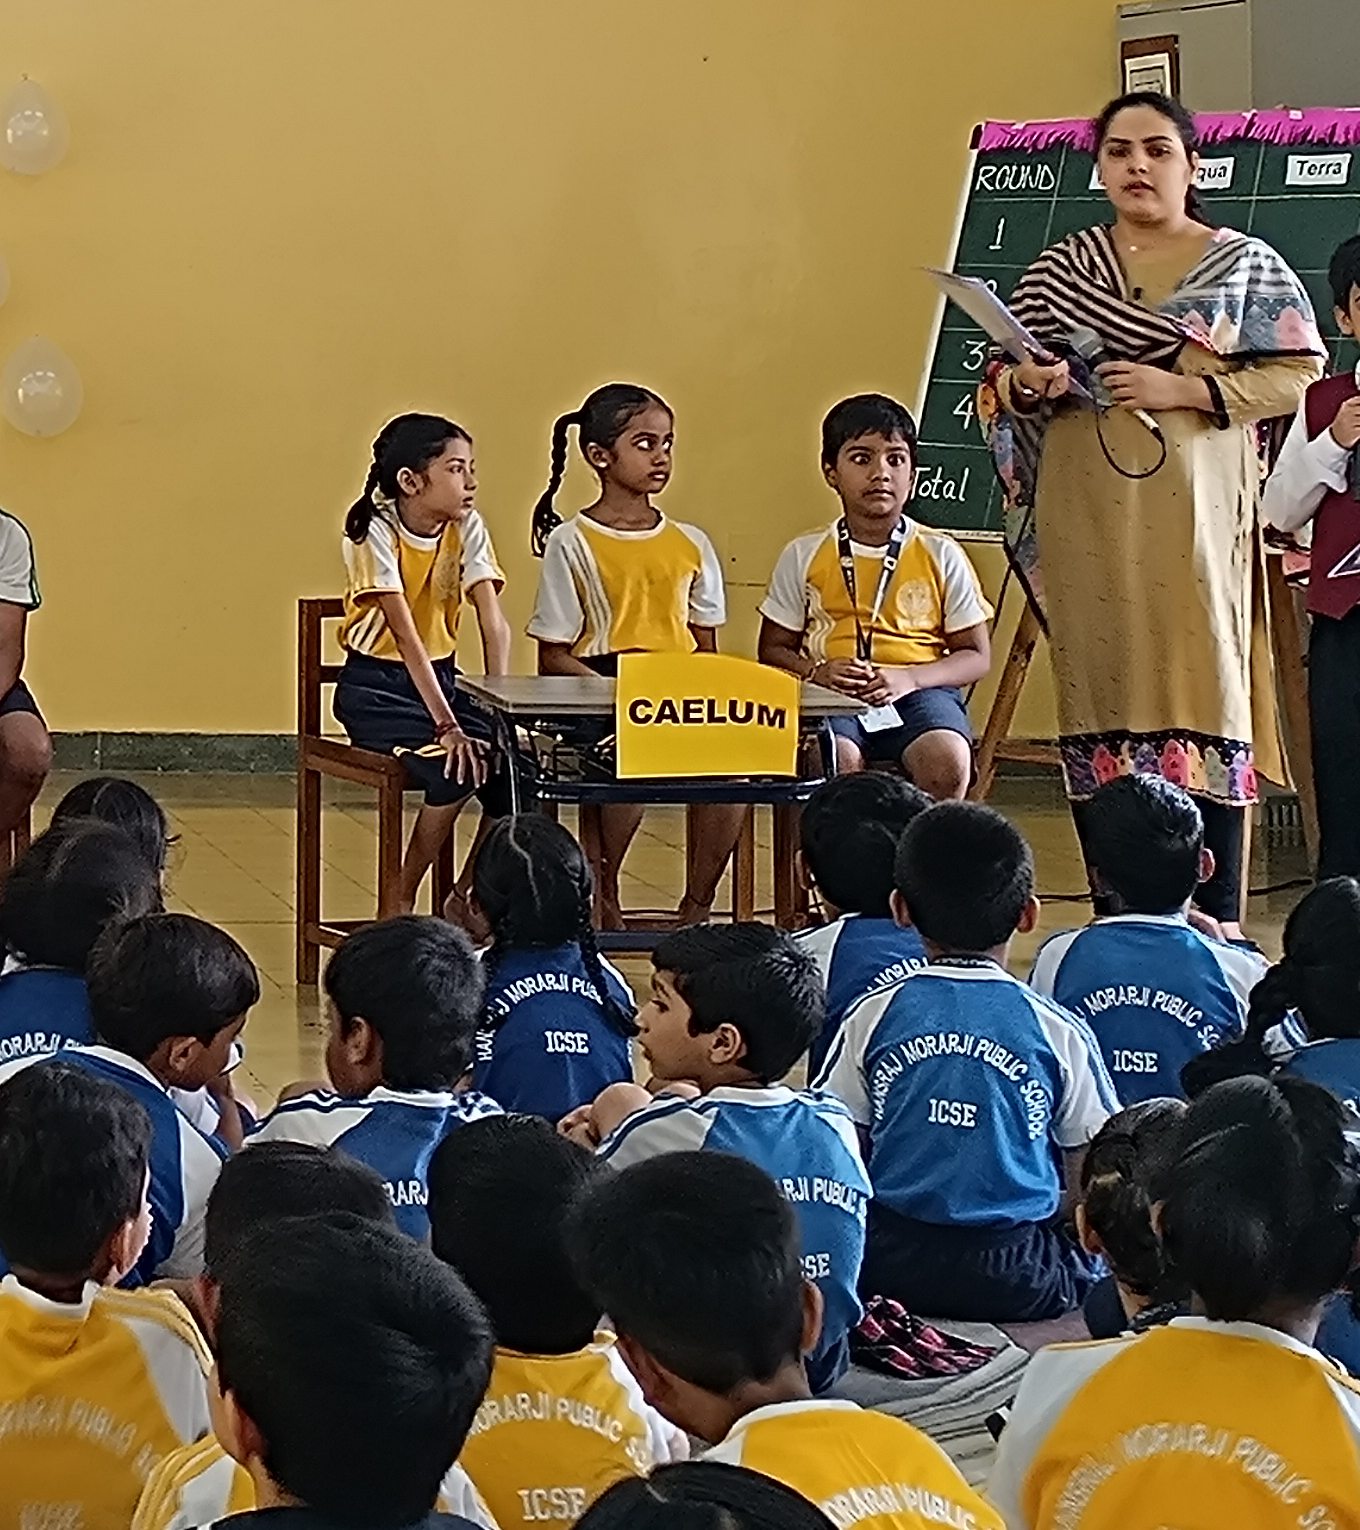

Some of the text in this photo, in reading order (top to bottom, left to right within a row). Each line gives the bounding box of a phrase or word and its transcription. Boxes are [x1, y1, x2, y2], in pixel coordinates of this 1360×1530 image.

[975, 164, 1055, 192] ROUND
[1197, 166, 1228, 183] qua
[1296, 160, 1342, 176] Terra
[989, 217, 1005, 251] 1
[962, 339, 984, 371] 3
[952, 393, 974, 430] 4
[910, 466, 970, 502] Total
[628, 698, 787, 729] CAELUM
[503, 973, 569, 1005] MORARJI
[1083, 985, 1150, 1016] MORARJI
[1152, 990, 1203, 1028] PUBLIC
[544, 1031, 589, 1054] ICSE
[1113, 1049, 1158, 1073] ICSE
[900, 1032, 975, 1065] MORARJI
[974, 1039, 1028, 1081] PUBLIC
[1020, 1079, 1050, 1141] SCHOOL
[928, 1099, 978, 1128] ICSE
[798, 1253, 830, 1280] SE
[557, 1397, 622, 1442] PUBLIC
[1227, 1435, 1313, 1505] PUBLIC
